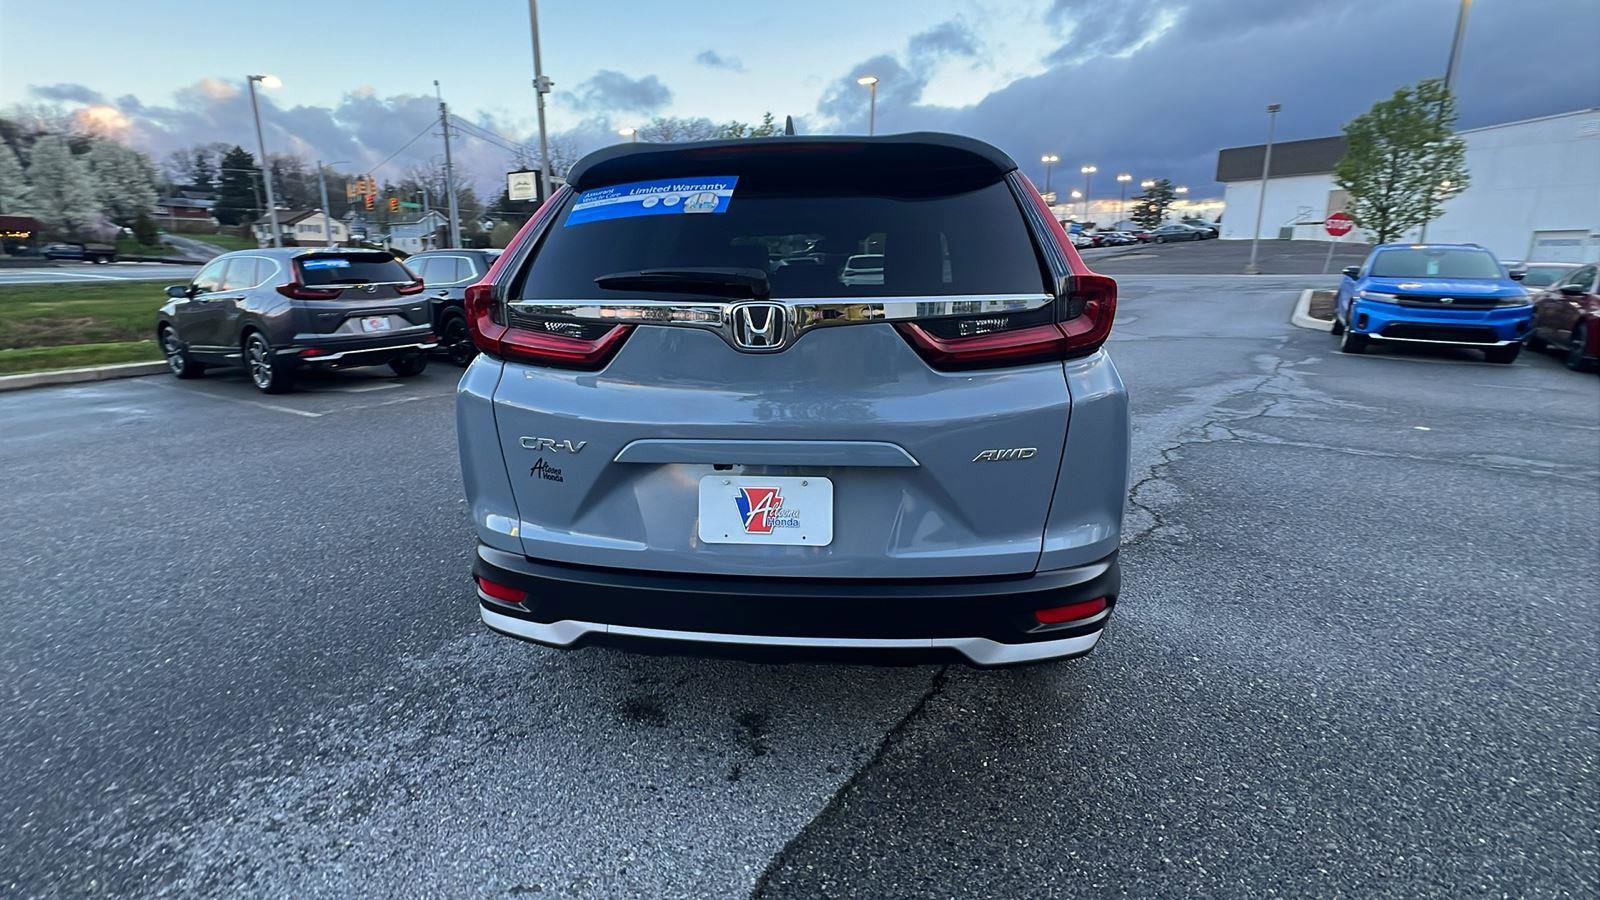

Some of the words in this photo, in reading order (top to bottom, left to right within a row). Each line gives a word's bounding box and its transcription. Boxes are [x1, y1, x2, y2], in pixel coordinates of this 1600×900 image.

[629, 184, 671, 195] Limited
[673, 183, 727, 191] Warranty
[1326, 220, 1353, 229] STOP
[520, 436, 587, 453] CR-V
[972, 447, 1037, 462] AWD
[767, 517, 800, 528] Honda
